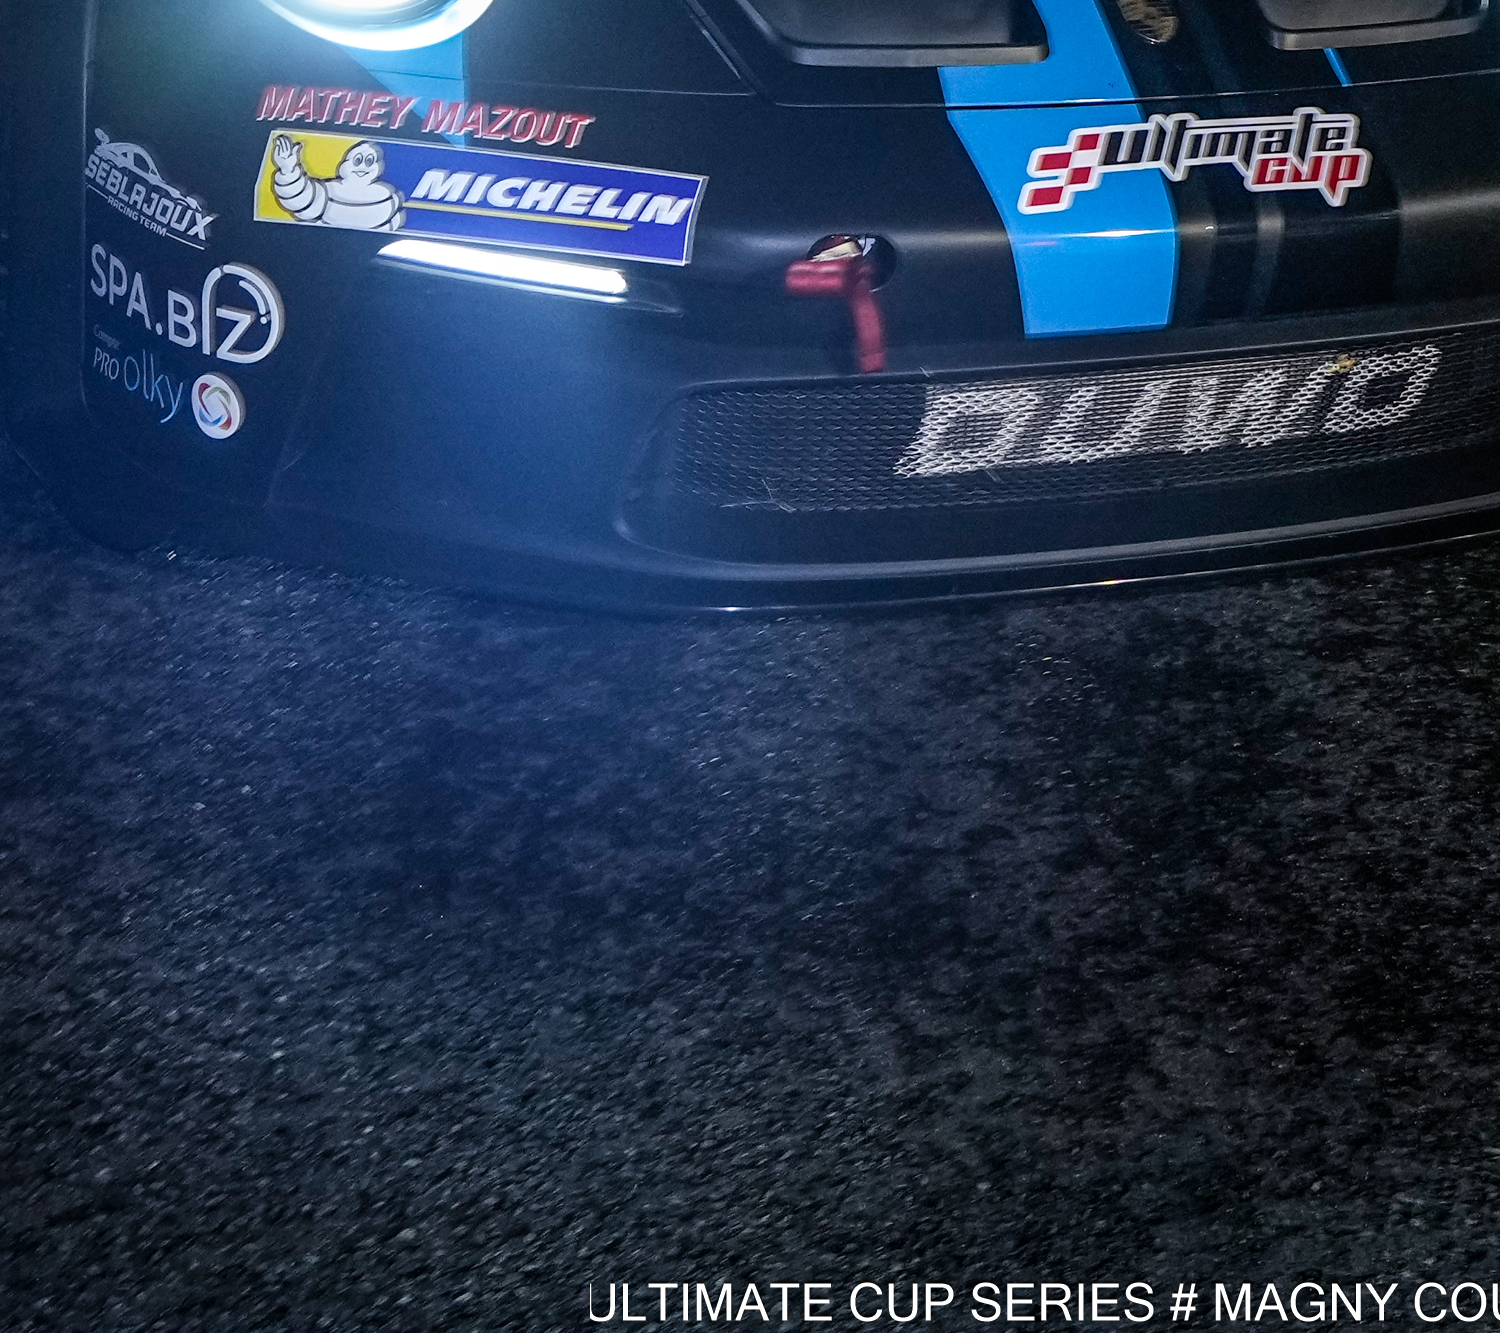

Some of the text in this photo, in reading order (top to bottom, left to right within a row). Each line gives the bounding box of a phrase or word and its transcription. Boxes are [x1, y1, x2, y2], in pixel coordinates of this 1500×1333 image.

[255, 85, 596, 149] MATHEY MAZOUT
[85, 155, 214, 241] SEBLAJOUX
[106, 195, 168, 238] RACING TEAM
[410, 167, 696, 227] MICHELIN
[93, 346, 120, 381] PRO
[893, 343, 1443, 479] DUWO
